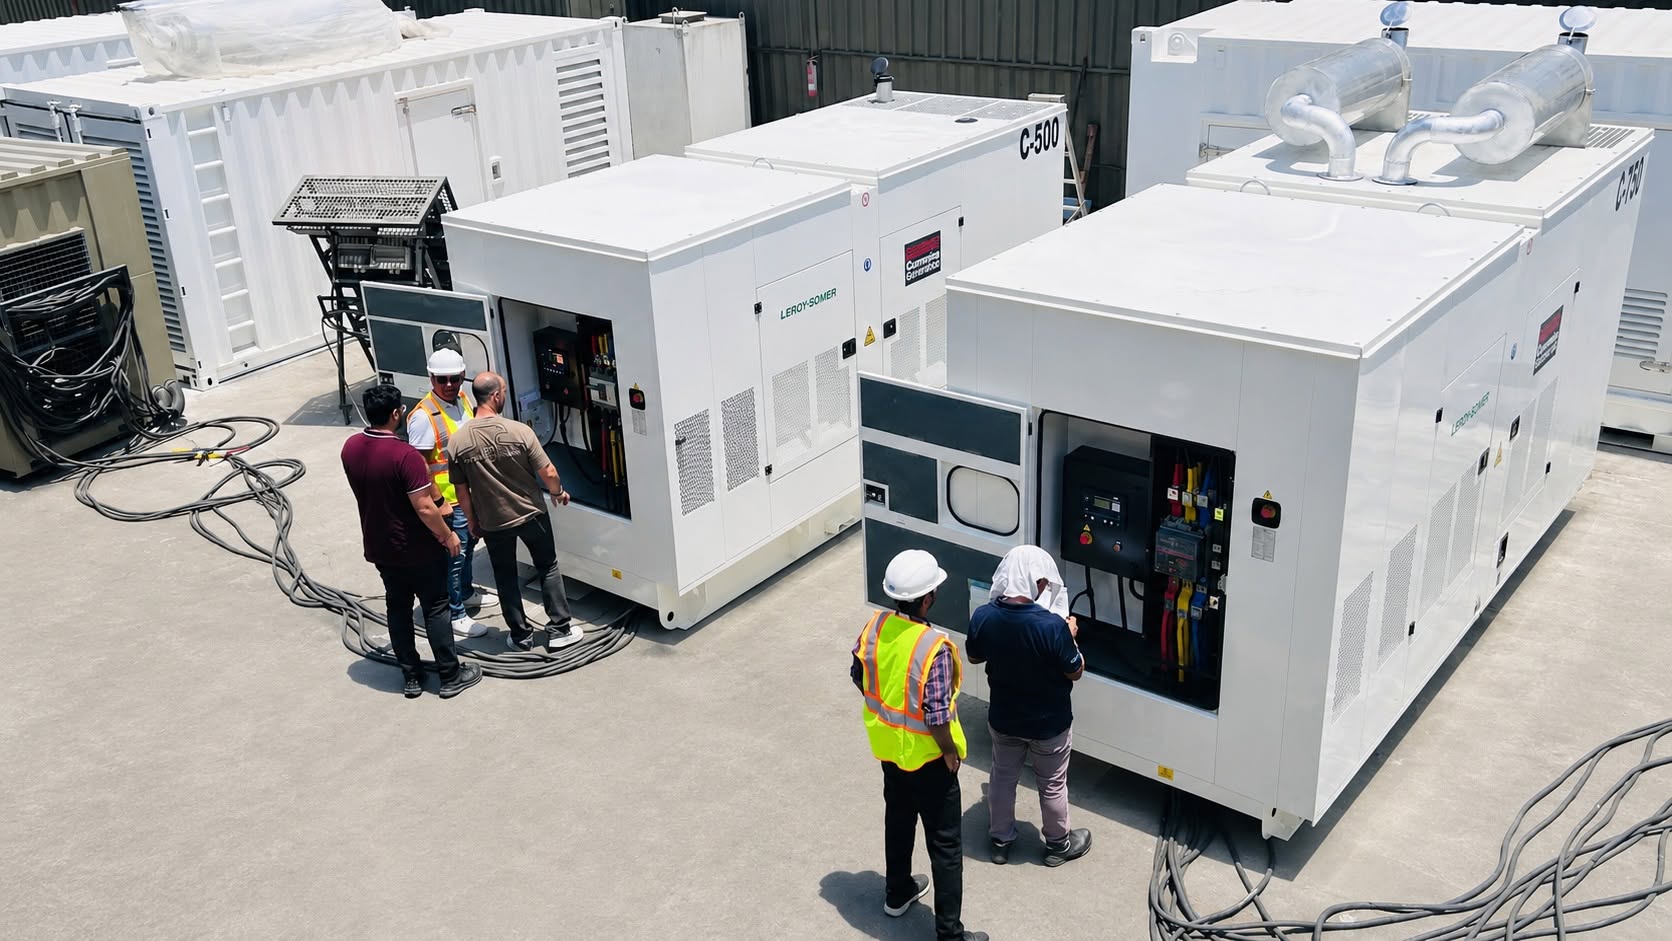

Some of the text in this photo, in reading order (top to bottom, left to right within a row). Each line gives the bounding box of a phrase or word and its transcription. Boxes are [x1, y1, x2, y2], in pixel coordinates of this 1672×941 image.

[1020, 116, 1059, 160] C-500
[1615, 156, 1644, 211] C-750
[780, 287, 837, 320] LEROY-SOMER
